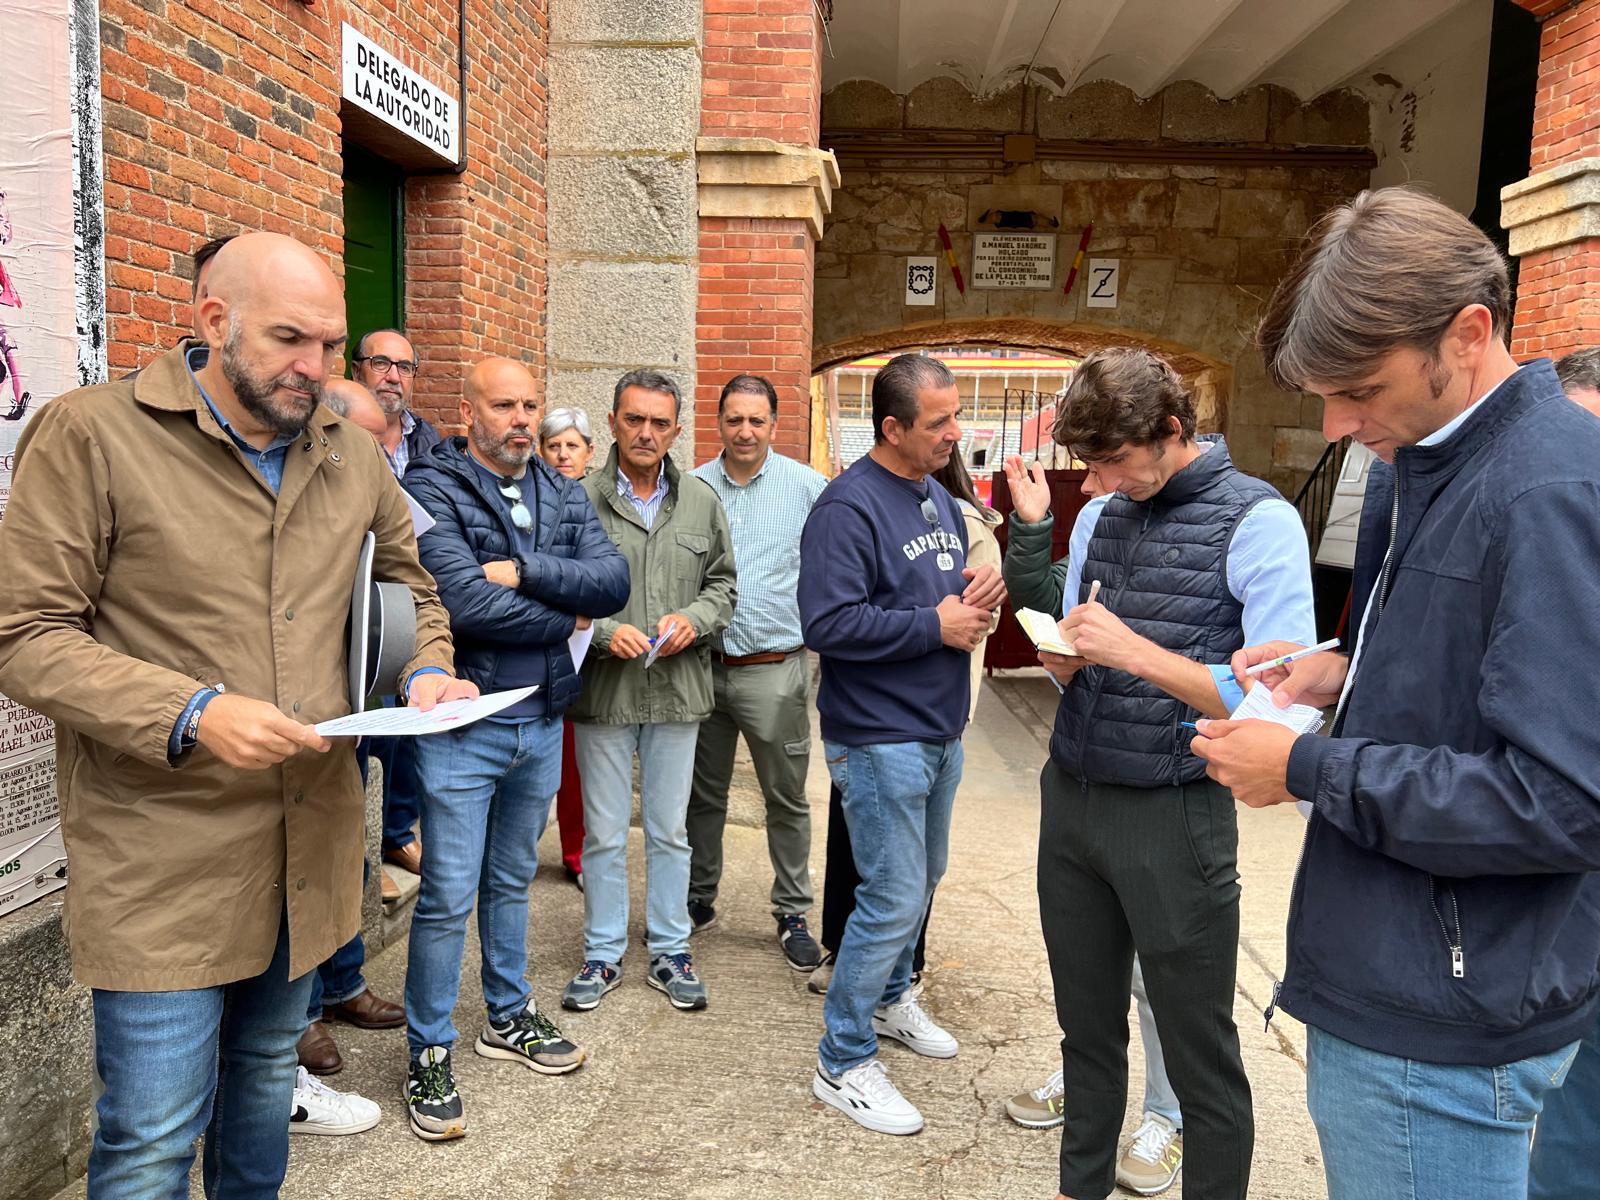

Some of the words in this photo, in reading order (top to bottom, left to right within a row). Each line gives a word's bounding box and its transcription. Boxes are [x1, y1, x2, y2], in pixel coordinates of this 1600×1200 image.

[357, 42, 431, 110] DELEGADO
[434, 95, 449, 123] DE
[355, 72, 373, 105] LA
[375, 87, 451, 150] AUTORIDAD
[14, 716, 53, 736] MANZA
[25, 764, 32, 773] DE
